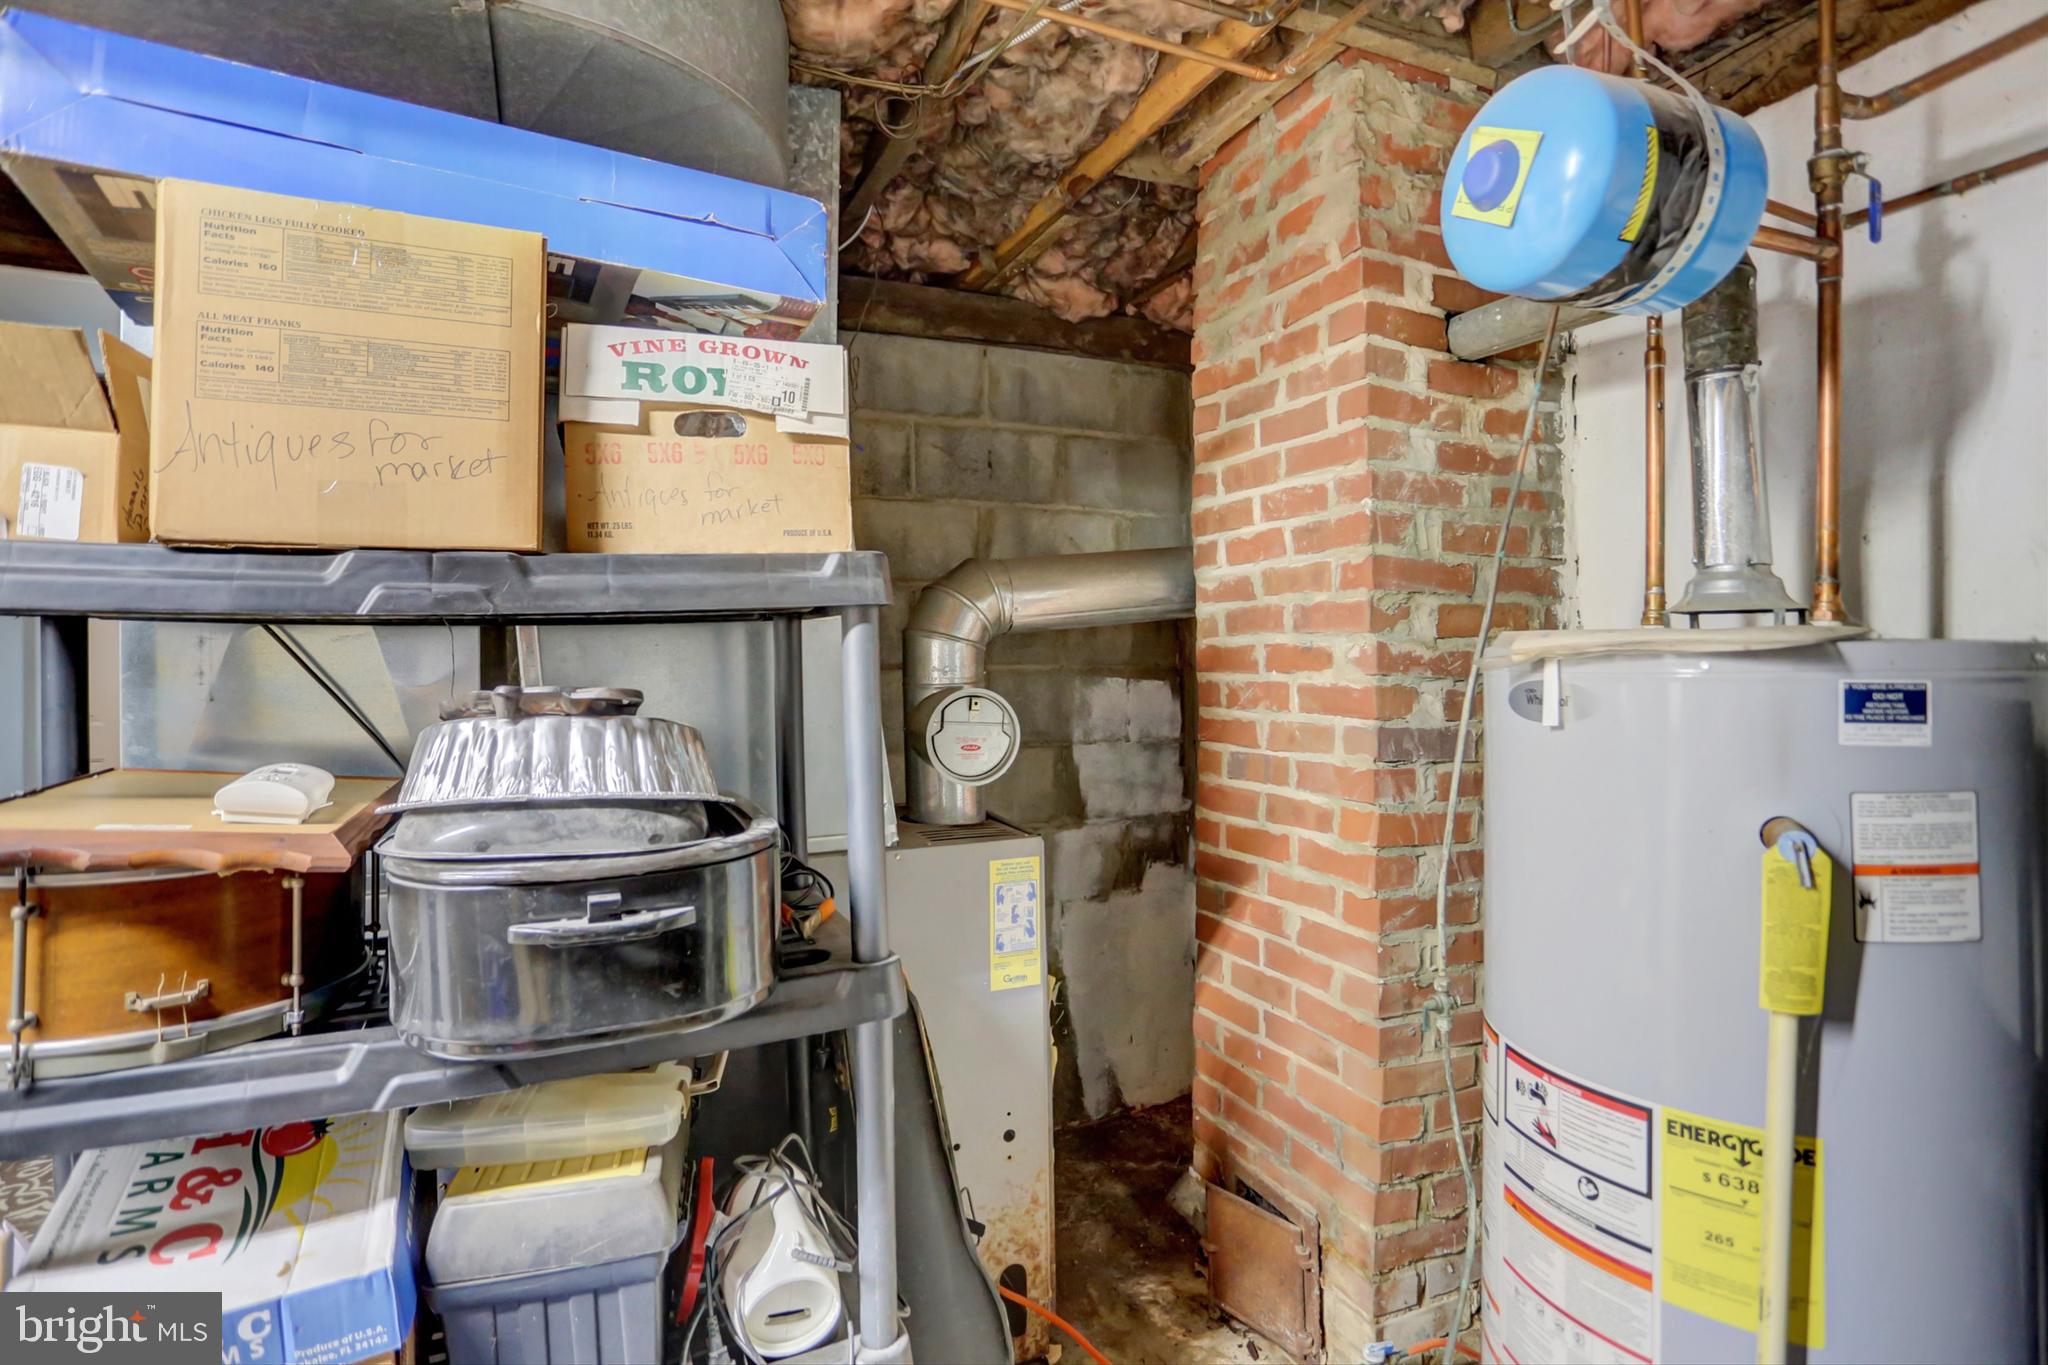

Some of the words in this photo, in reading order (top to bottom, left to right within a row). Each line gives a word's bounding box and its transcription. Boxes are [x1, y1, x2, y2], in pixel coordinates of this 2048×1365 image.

[201, 208, 252, 221] CHICKEN
[255, 215, 282, 226] LEGS
[285, 220, 318, 231] FULLY
[320, 224, 366, 237] COOKED
[203, 221, 257, 235] Nutrition
[203, 230, 236, 241] Facts
[203, 256, 249, 269] Calories
[257, 262, 278, 271] 160
[198, 312, 219, 321] ALL
[222, 314, 254, 323] MEAT
[257, 317, 302, 328] FRANKS
[200, 325, 253, 337] Nutrition
[200, 334, 232, 343] Facts
[607, 338, 687, 358] VINE
[699, 339, 810, 370] GROWN
[200, 360, 246, 371] Calories
[255, 364, 275, 373] 140
[782, 390, 796, 404] 10
[154, 400, 355, 490] Antiques
[375, 448, 507, 486] market
[701, 494, 783, 527] market
[1718, 1173, 1760, 1195] 638
[97, 1151, 185, 1265] ARMS
[1704, 1230, 1735, 1248] 265
[294, 1340, 340, 1360] Produce
[342, 1334, 354, 1345] of
